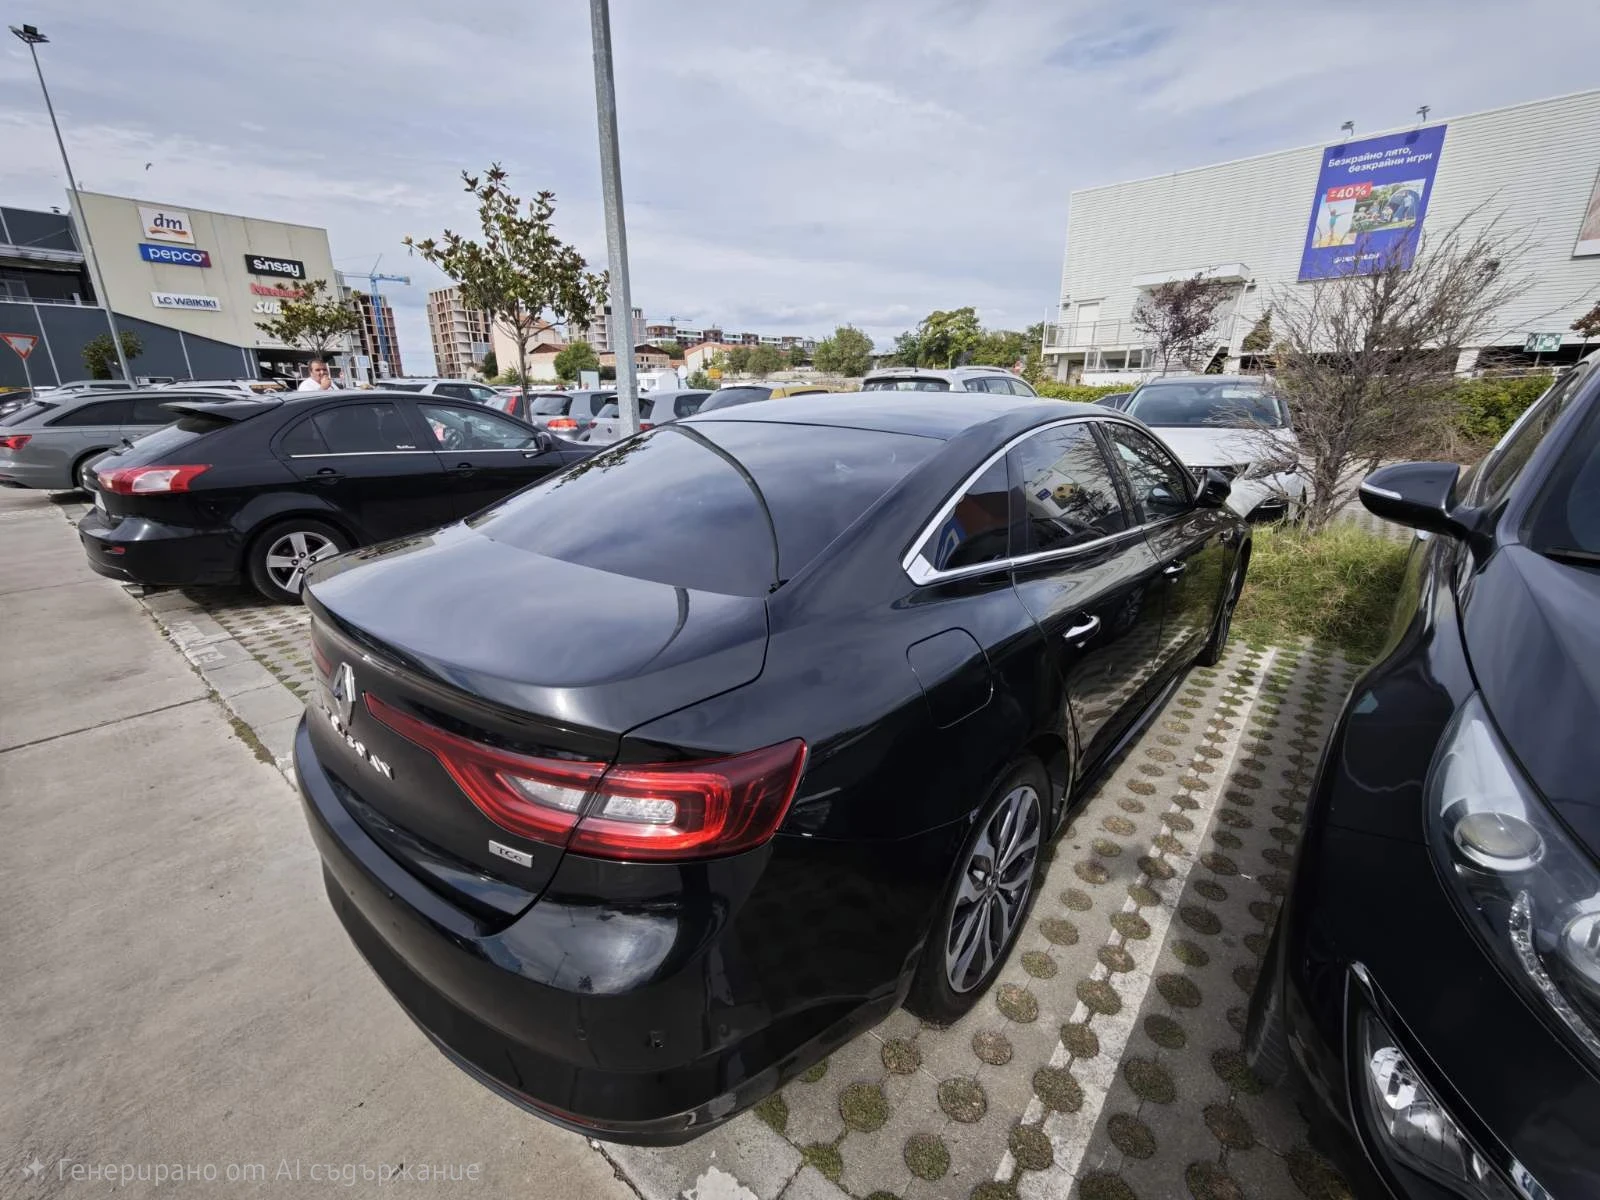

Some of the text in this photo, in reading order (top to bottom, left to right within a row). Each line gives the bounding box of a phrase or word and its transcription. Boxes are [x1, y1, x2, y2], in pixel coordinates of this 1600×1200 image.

[1328, 147, 1412, 167] Безкрайно лято,
[1348, 153, 1433, 173] безкрайни игри
[153, 213, 183, 230] dm
[148, 247, 203, 263] pepco
[253, 257, 300, 277] sinsay
[156, 295, 172, 305] LC
[252, 301, 288, 315] SUB
